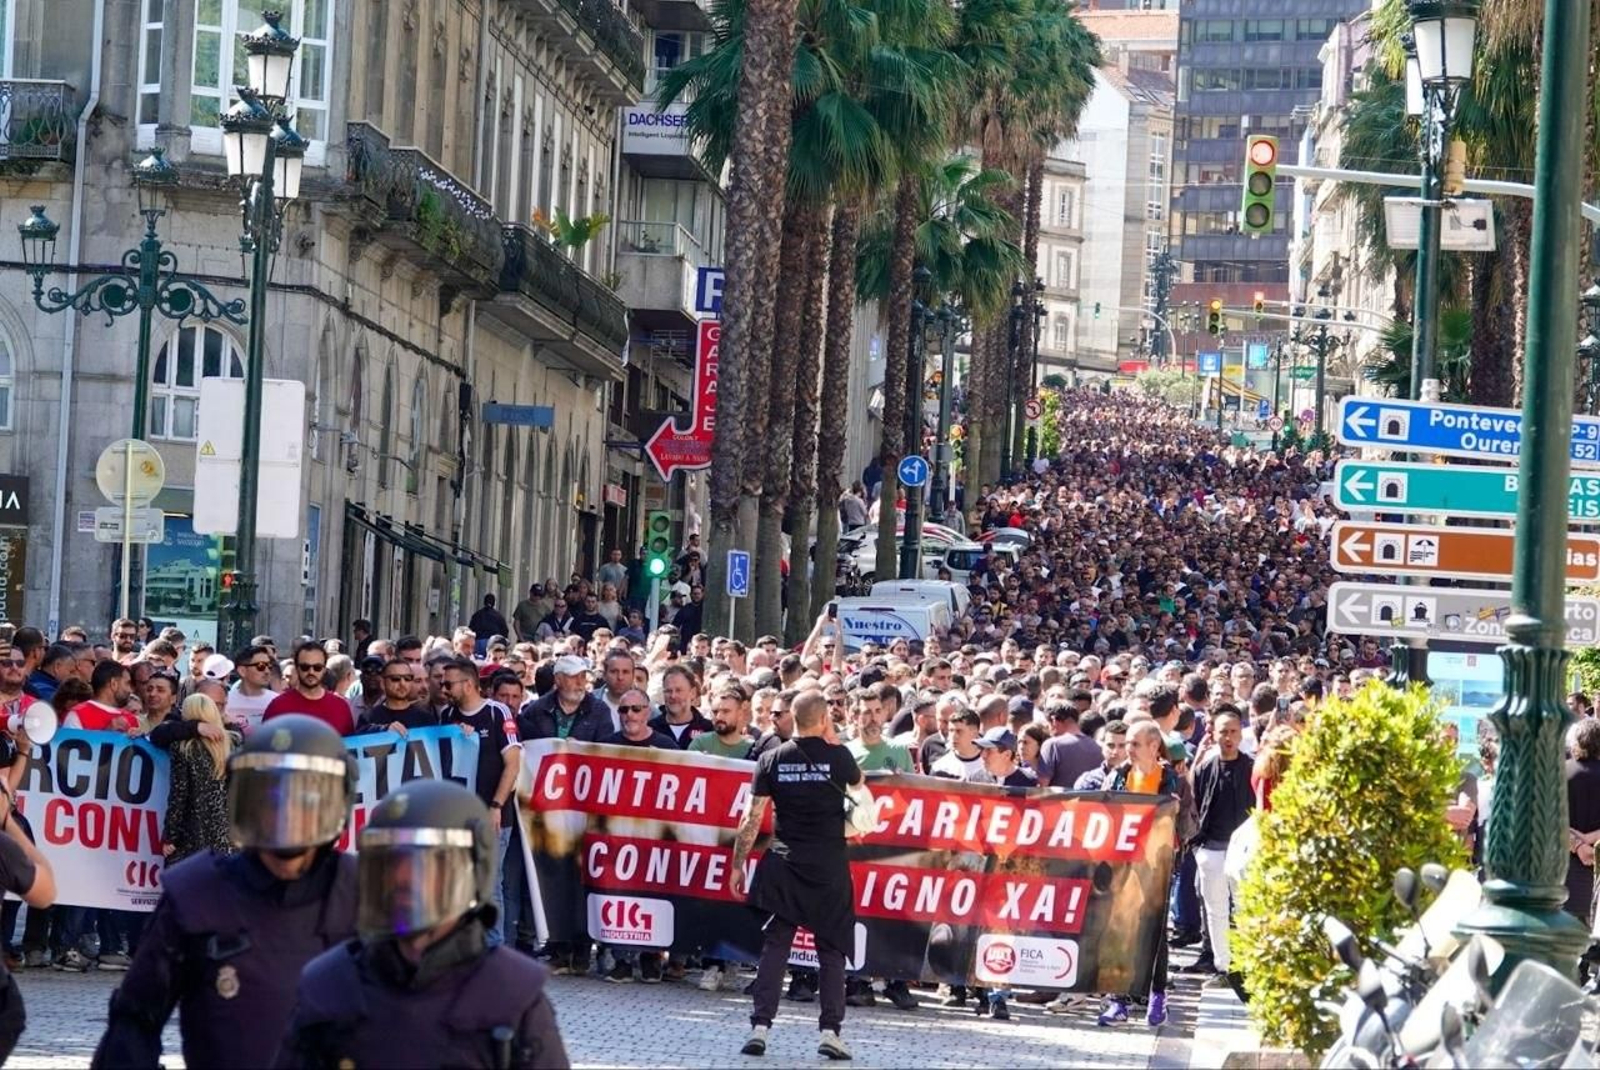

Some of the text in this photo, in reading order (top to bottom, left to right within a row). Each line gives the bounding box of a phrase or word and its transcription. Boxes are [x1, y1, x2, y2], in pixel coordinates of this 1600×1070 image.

[1430, 409, 1597, 439] Ponteve P-9
[1573, 444, 1596, 459] 52
[1566, 547, 1597, 567] ias
[1564, 603, 1595, 621] rto
[843, 617, 902, 631] Nuestro
[1464, 616, 1503, 636] Zon
[19, 737, 468, 805] RCIO TAL
[544, 763, 707, 814] CONTRA
[870, 795, 1143, 851] CARIEDADE
[44, 798, 165, 856] CONV
[588, 841, 1083, 924] CONVEN IGNO XA!
[601, 900, 652, 931] CIG
[601, 929, 651, 940] INDUSTRIA
[1020, 949, 1043, 959] FICA
